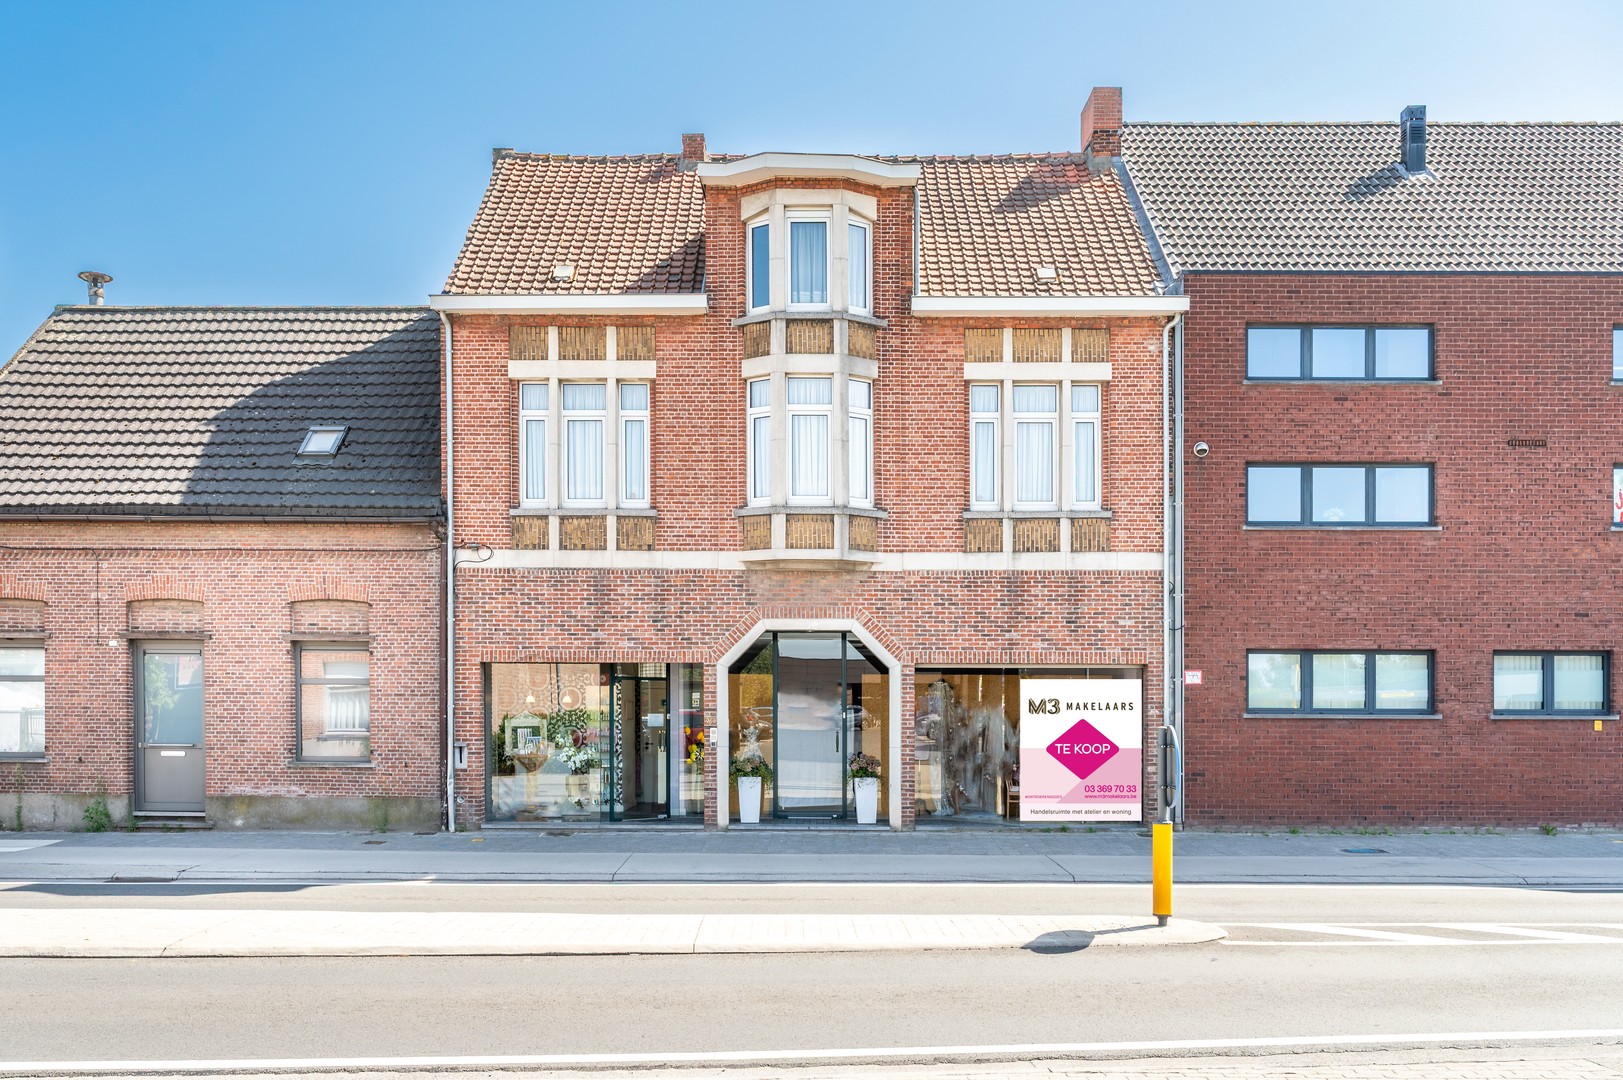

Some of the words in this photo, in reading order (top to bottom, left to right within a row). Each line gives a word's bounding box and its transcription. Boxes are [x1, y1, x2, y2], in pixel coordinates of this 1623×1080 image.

[1028, 698, 1061, 715] M3
[1066, 702, 1134, 711] MAKELAARS
[1055, 743, 1071, 754] TE
[1074, 743, 1111, 754] KOOP
[1084, 785, 1095, 793] 03
[1096, 785, 1113, 793] 369
[1114, 785, 1125, 793] 70
[1126, 785, 1137, 793] 33
